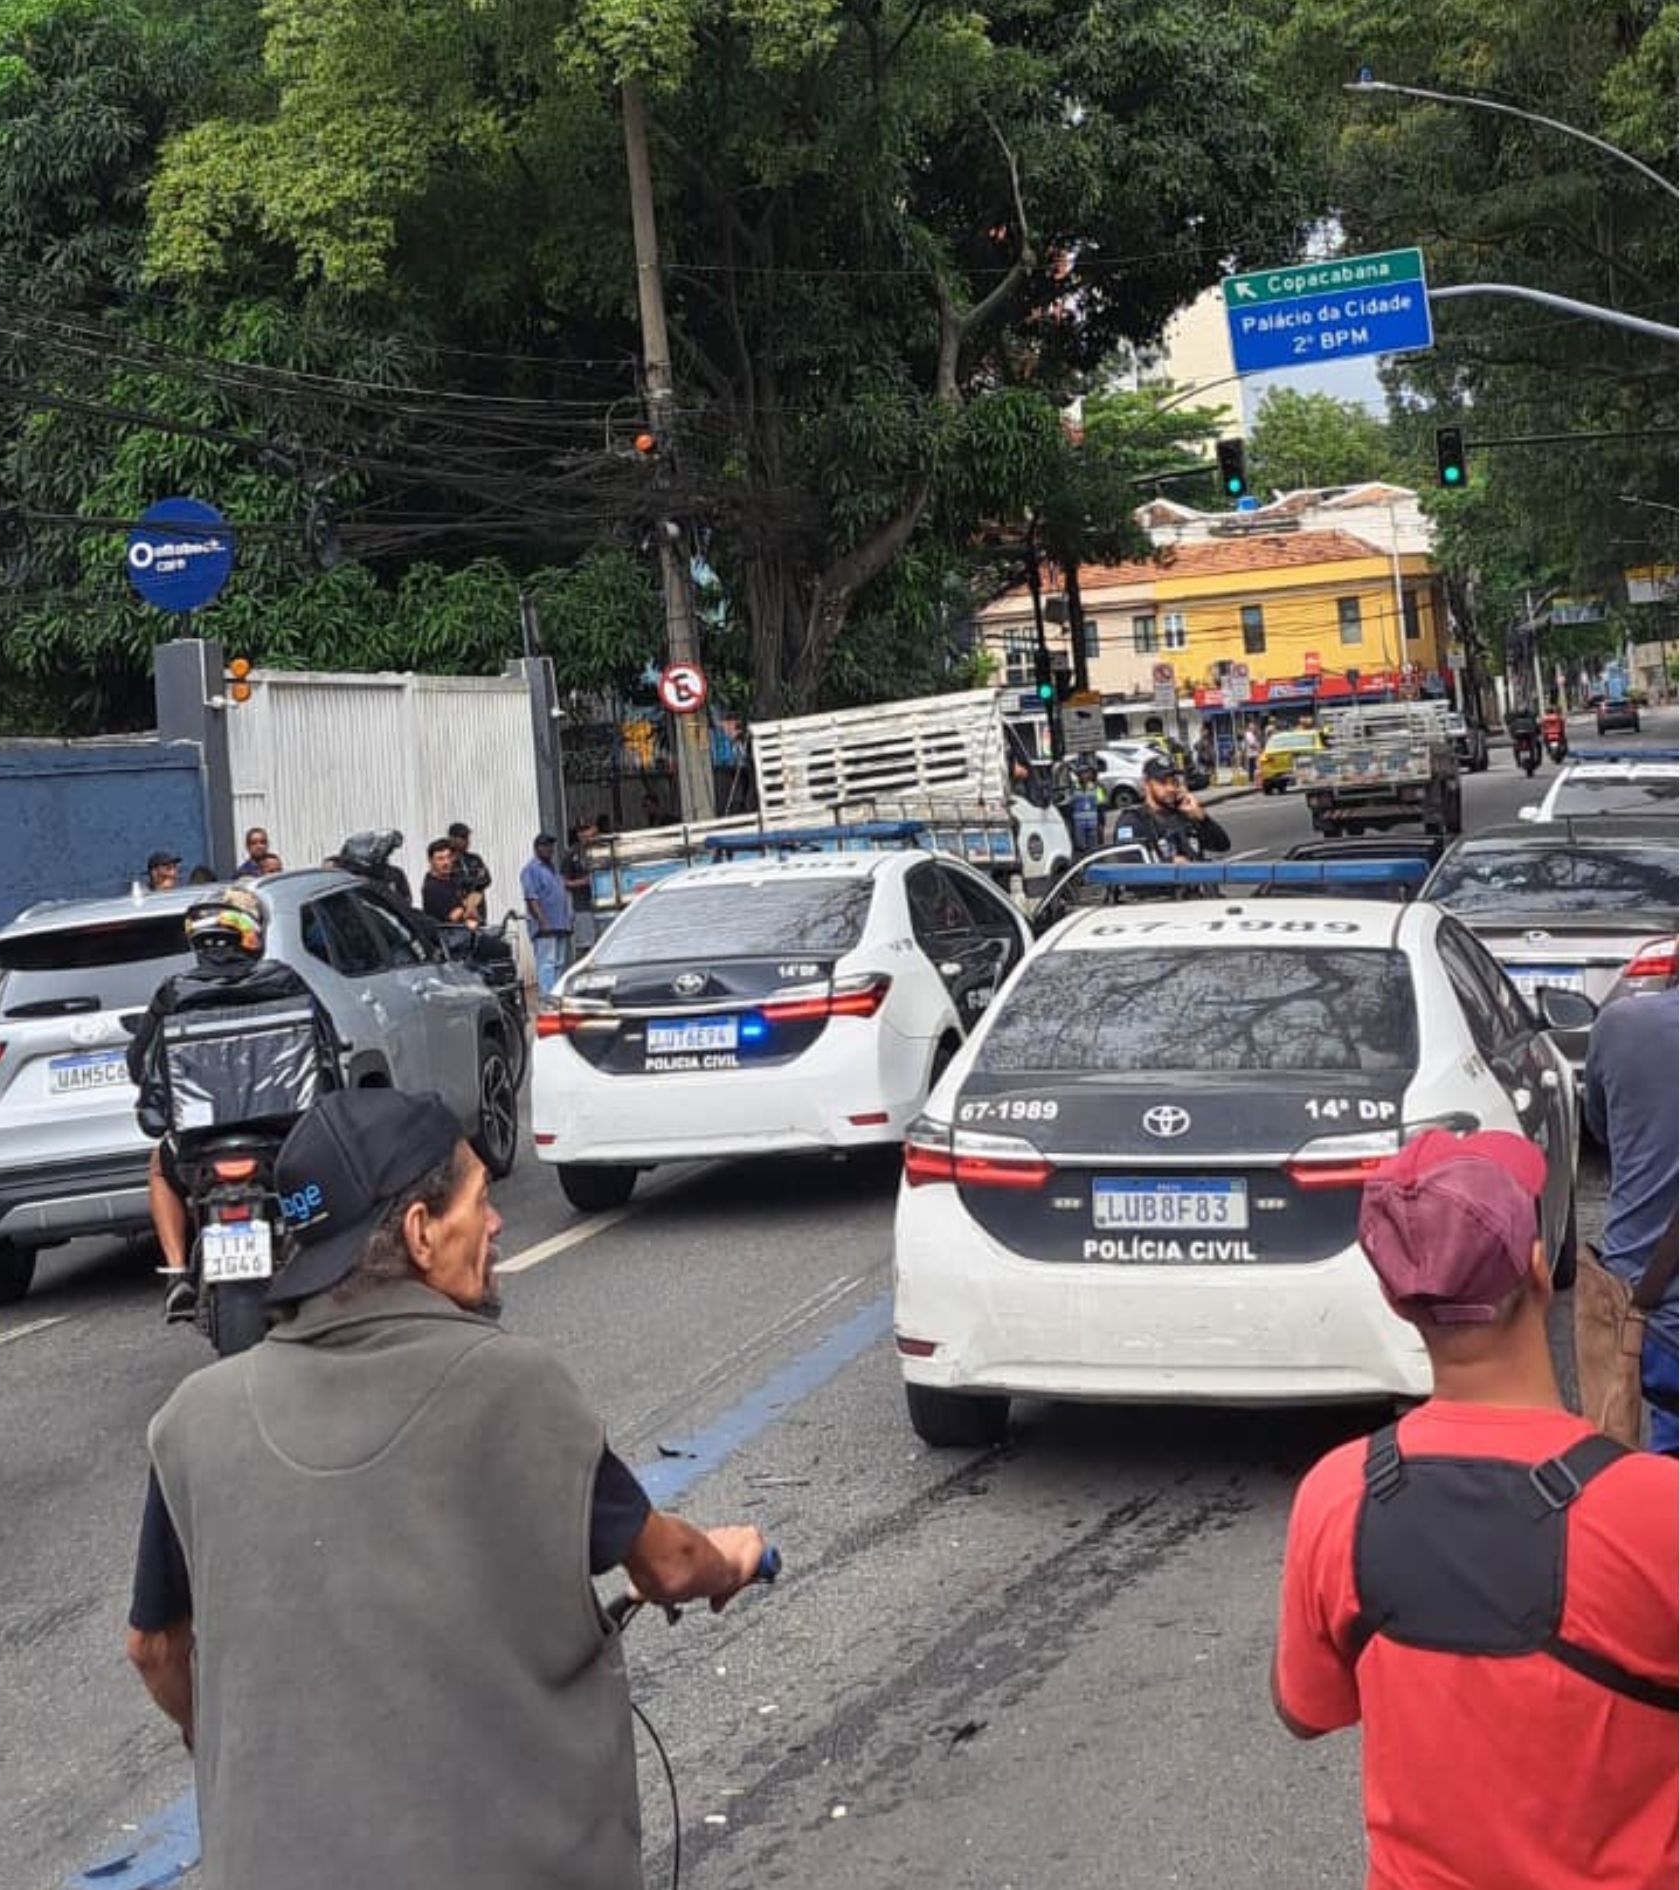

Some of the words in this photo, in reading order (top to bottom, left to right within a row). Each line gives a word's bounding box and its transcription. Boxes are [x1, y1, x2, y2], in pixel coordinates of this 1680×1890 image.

[1267, 262, 1391, 293] Copacabana
[1242, 307, 1312, 334] Palácio
[1316, 303, 1341, 322] da
[1344, 293, 1412, 318] Cidade
[1320, 326, 1369, 349] BPM
[1091, 920, 1361, 936] 67-1989
[704, 1054, 739, 1067] CIVIL
[960, 1101, 1058, 1121] 67-1989
[1359, 1100, 1396, 1120] DP
[1108, 1195, 1228, 1222] LUB8F83
[1083, 1235, 1182, 1260] POLÍCIA
[1190, 1241, 1256, 1260] CIVIL
